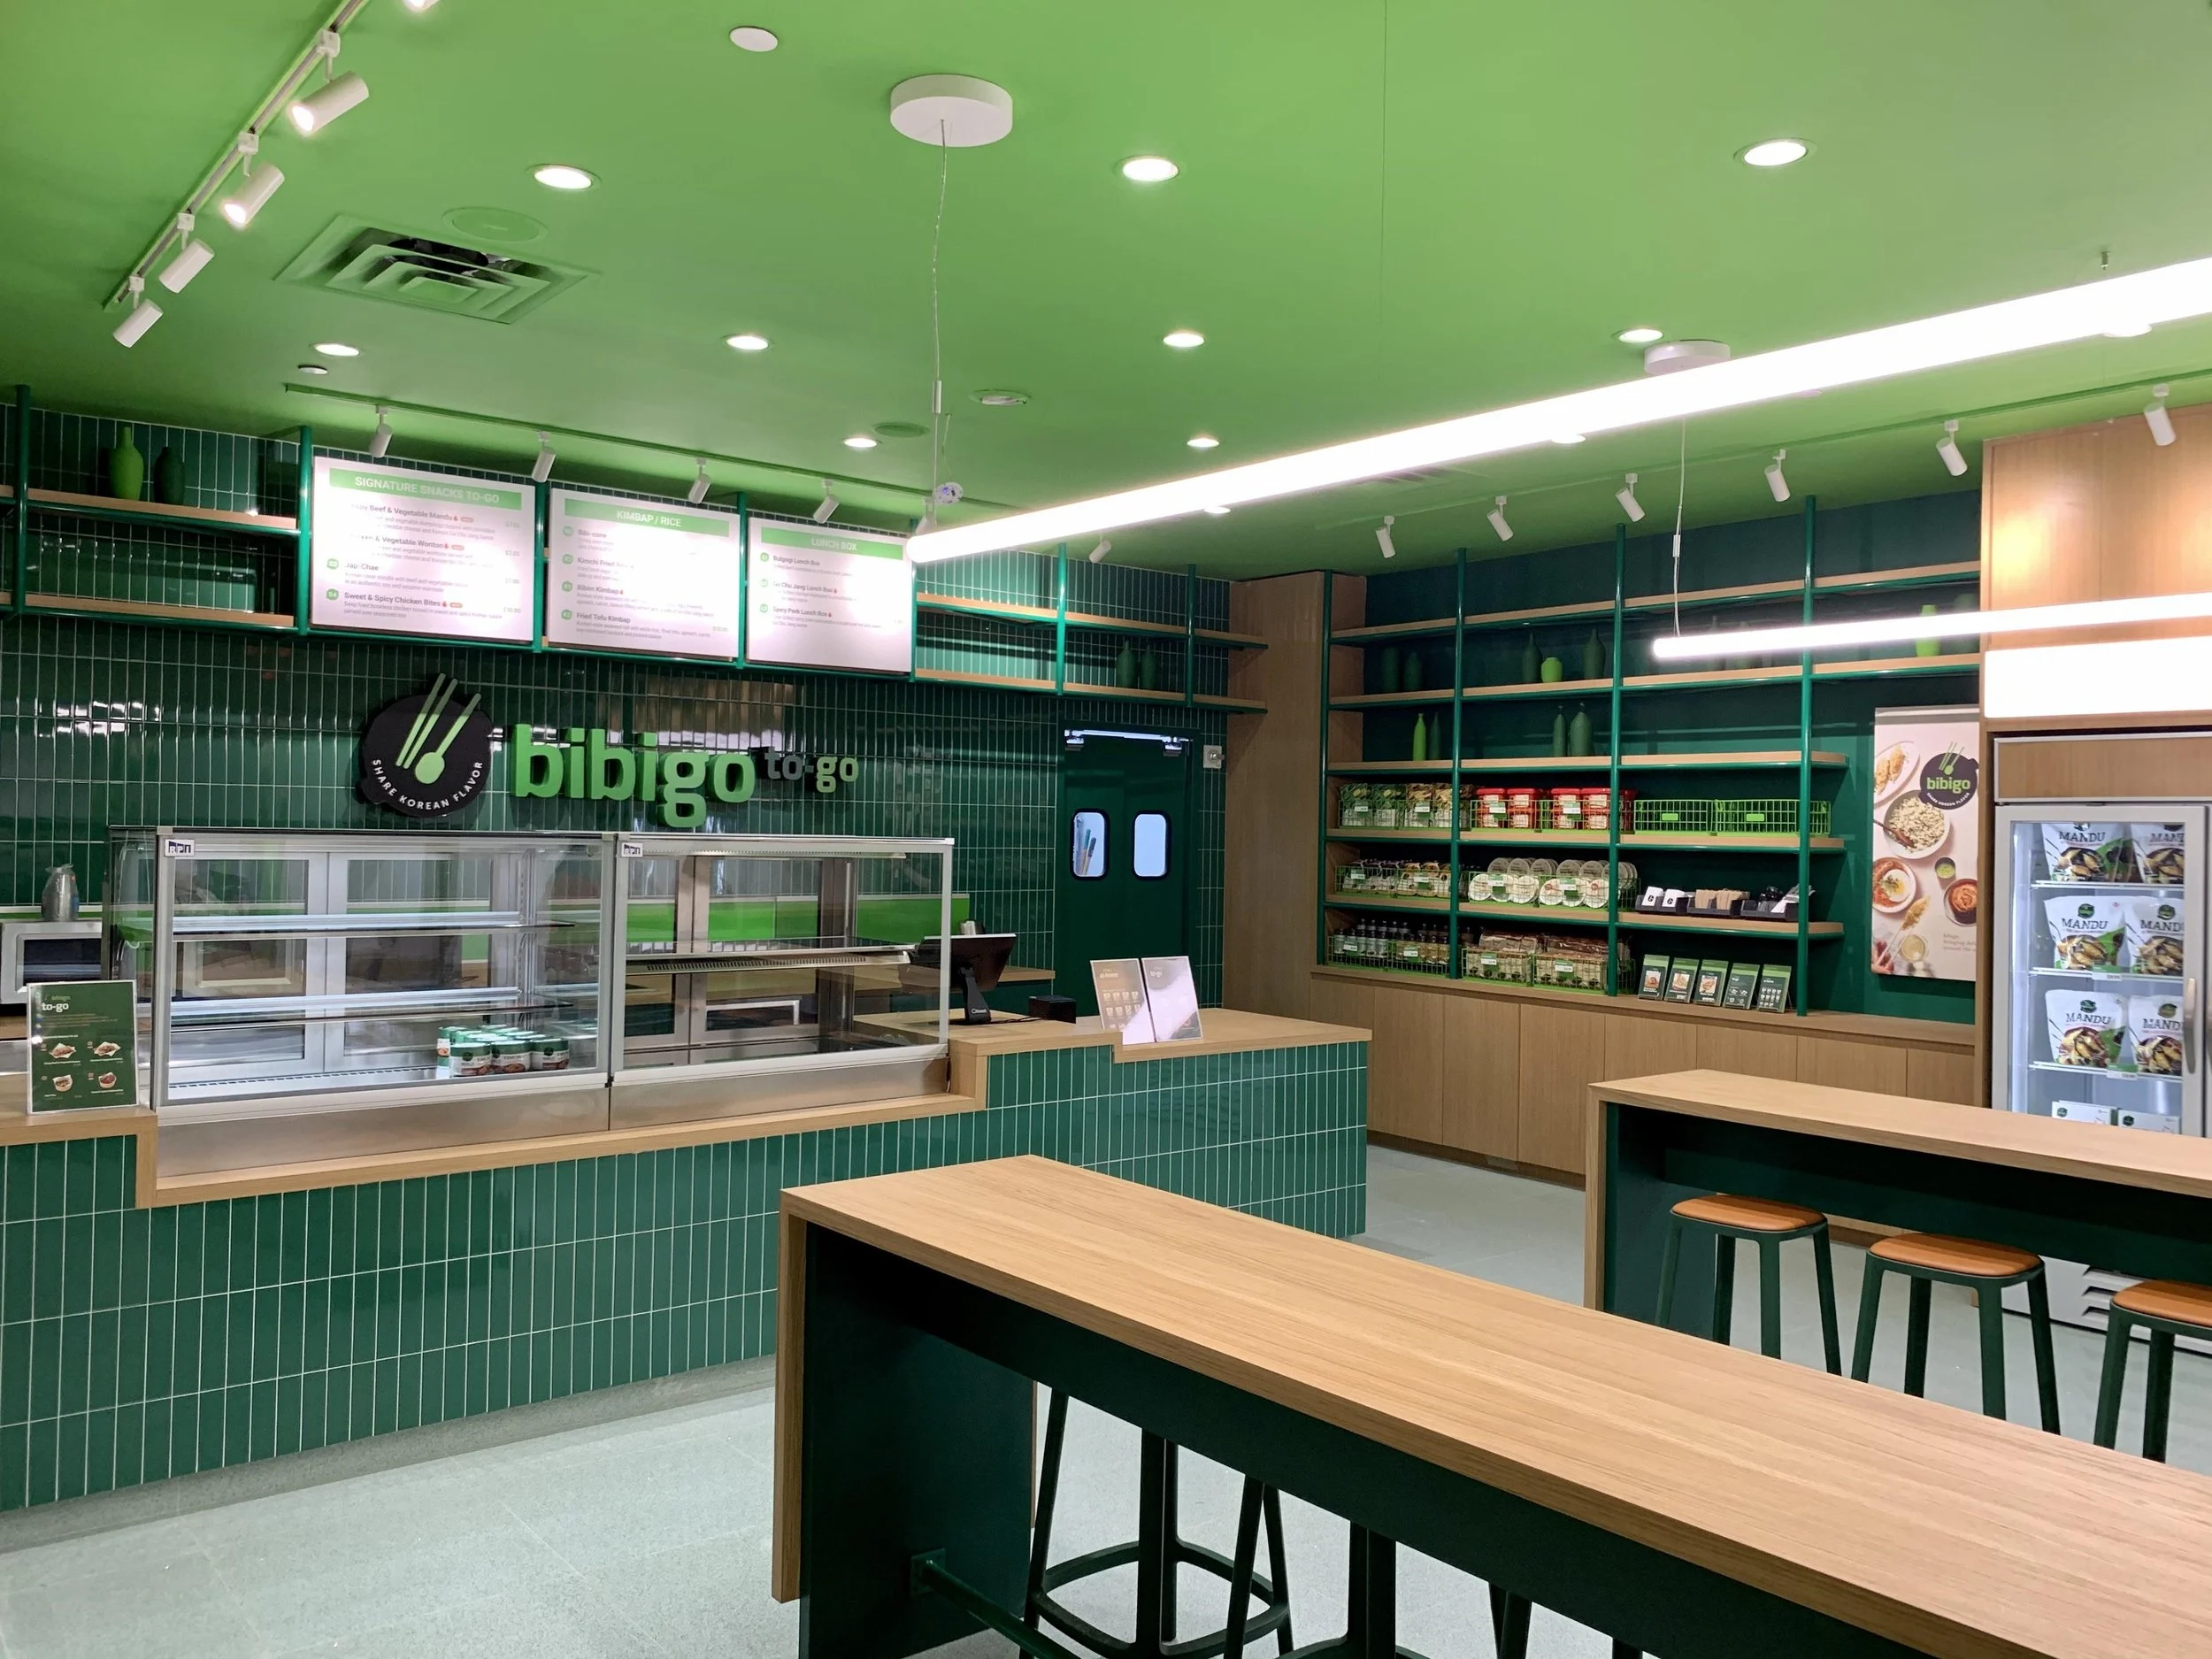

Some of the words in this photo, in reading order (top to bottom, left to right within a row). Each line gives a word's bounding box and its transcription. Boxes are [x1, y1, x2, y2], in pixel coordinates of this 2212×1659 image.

[355, 476, 418, 494] SIGNATURE
[420, 486, 463, 499] SNACKS
[465, 490, 500, 503] TO-GO
[394, 507, 428, 518] Vegetable
[429, 511, 453, 521] Mandu
[617, 510, 654, 523] KIMBAP
[660, 516, 682, 527] RICE
[381, 535, 417, 546] Vegetable
[418, 540, 443, 549] Wonton
[811, 537, 840, 549] LUNCH
[841, 541, 857, 551] BOX
[577, 557, 599, 565] Kimchi
[595, 586, 619, 595] Kimbap
[344, 592, 366, 601] Sweet
[374, 595, 394, 604] Spicy
[395, 595, 423, 606] Chicken
[608, 615, 631, 624] Kimbap
[511, 723, 756, 828] bibigo
[764, 747, 859, 794] to-go
[373, 759, 397, 796] SHARE
[399, 795, 449, 810] KOREAN
[452, 762, 483, 802] FLAVOR
[1926, 777, 1971, 795] bibigo
[2059, 831, 2107, 842] MANDU
[2062, 918, 2108, 930] MANDU
[2140, 919, 2184, 932] MAND
[42, 1002, 69, 1013] to-go
[2066, 1013, 2112, 1025] MANDU
[2143, 1018, 2184, 1031] MAND
